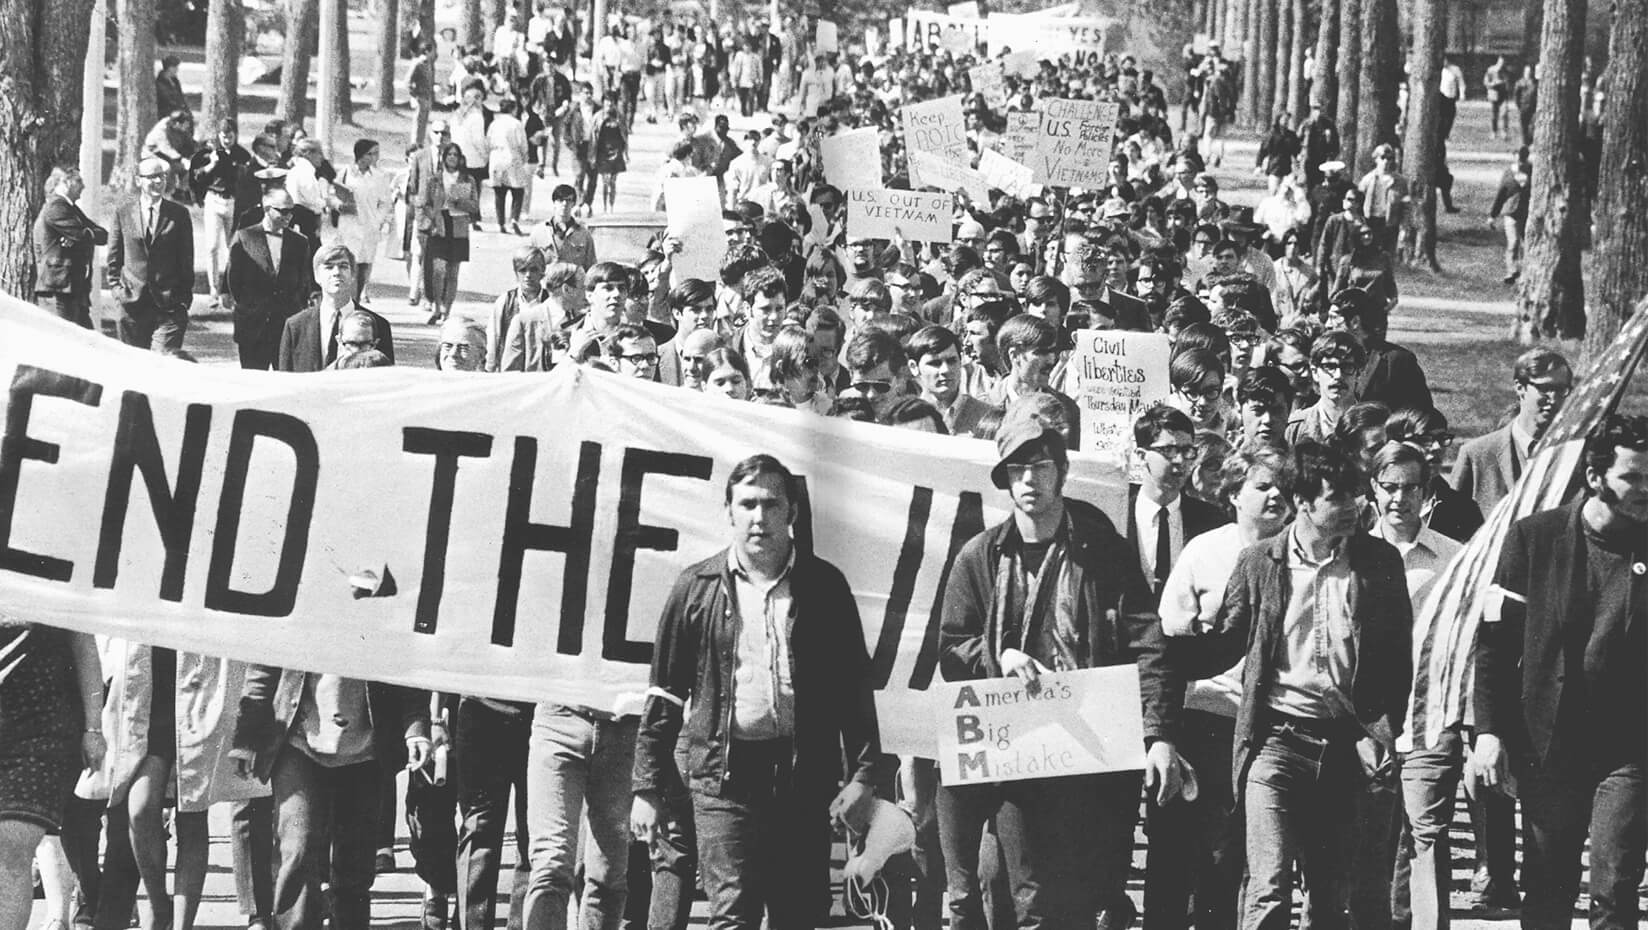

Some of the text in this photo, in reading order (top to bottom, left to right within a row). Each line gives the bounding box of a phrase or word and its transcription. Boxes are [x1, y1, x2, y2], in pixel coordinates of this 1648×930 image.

[1068, 26, 1102, 44] YES
[1074, 48, 1098, 67] NO
[909, 111, 945, 127] Keep
[1047, 99, 1118, 122] CHALLENGE
[1079, 129, 1109, 143] Policies
[1052, 139, 1103, 158] No More
[1045, 156, 1104, 185] VIETNAMS
[852, 190, 952, 211] U.S. OUT OF
[865, 205, 938, 224] VIETNAM
[1093, 336, 1126, 357] Civil
[1083, 355, 1146, 383] liberties
[1083, 394, 1127, 414] Thursday
[0, 363, 320, 617] END
[402, 426, 714, 665] THE
[953, 681, 1073, 709] Ameria's
[956, 714, 1010, 750] Big
[957, 743, 1074, 781] Mistake
